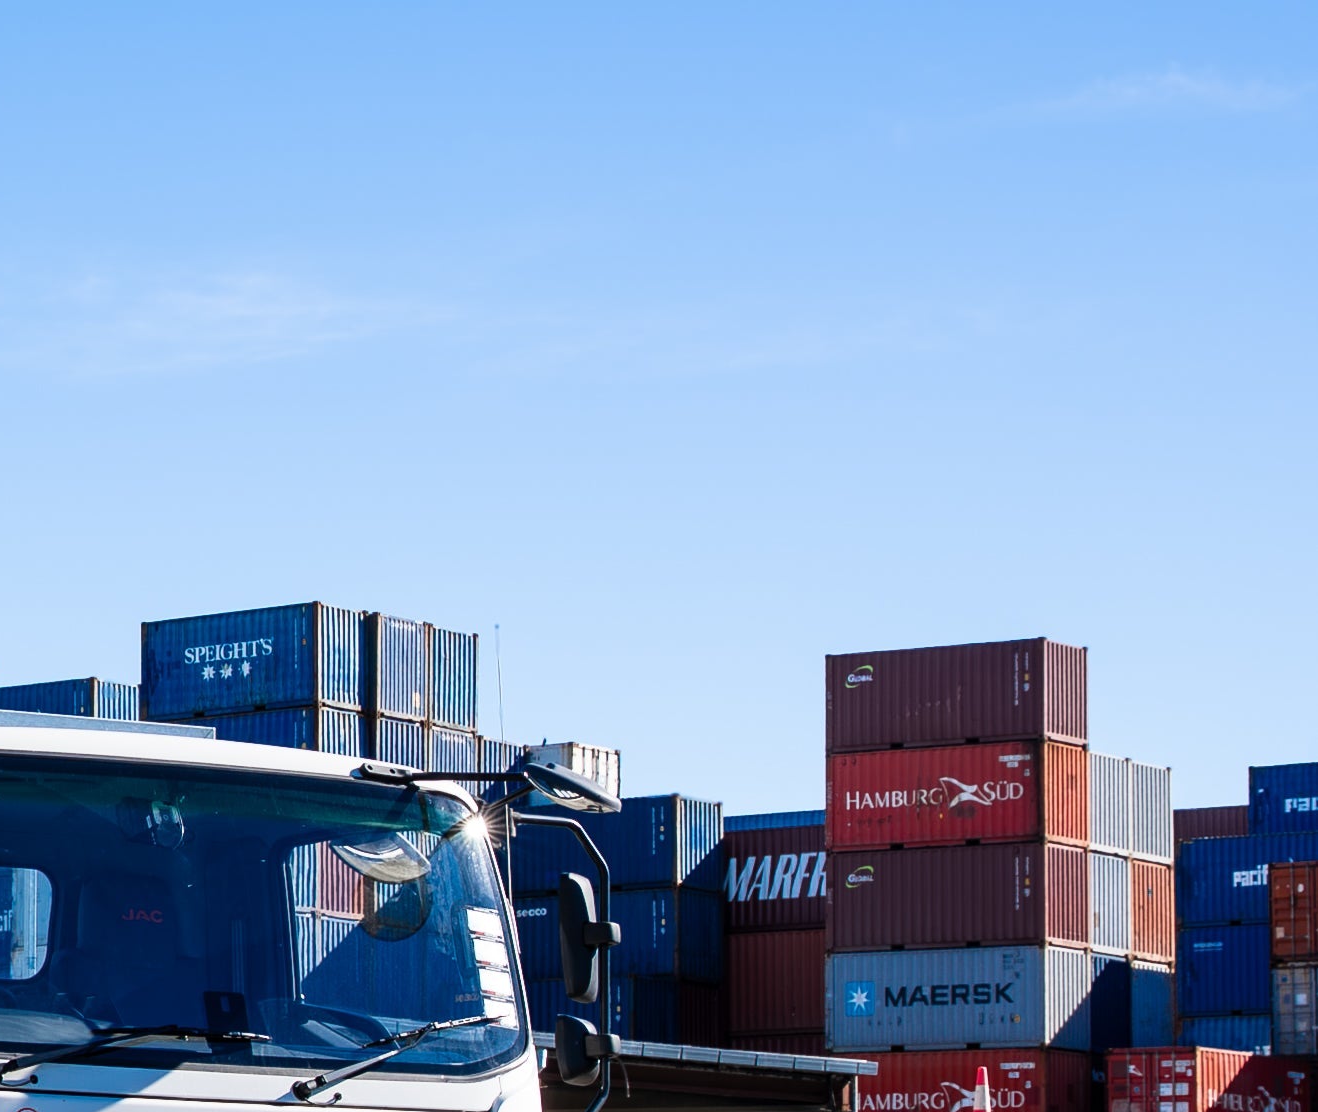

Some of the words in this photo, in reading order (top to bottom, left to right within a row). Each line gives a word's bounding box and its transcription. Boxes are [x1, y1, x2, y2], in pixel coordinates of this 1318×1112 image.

[185, 638, 272, 664] SPEIGHT'S
[846, 788, 944, 810] HAMBURG
[983, 780, 1024, 801] SÜD
[122, 908, 164, 924] JAC
[884, 982, 1014, 1007] MAERSK
